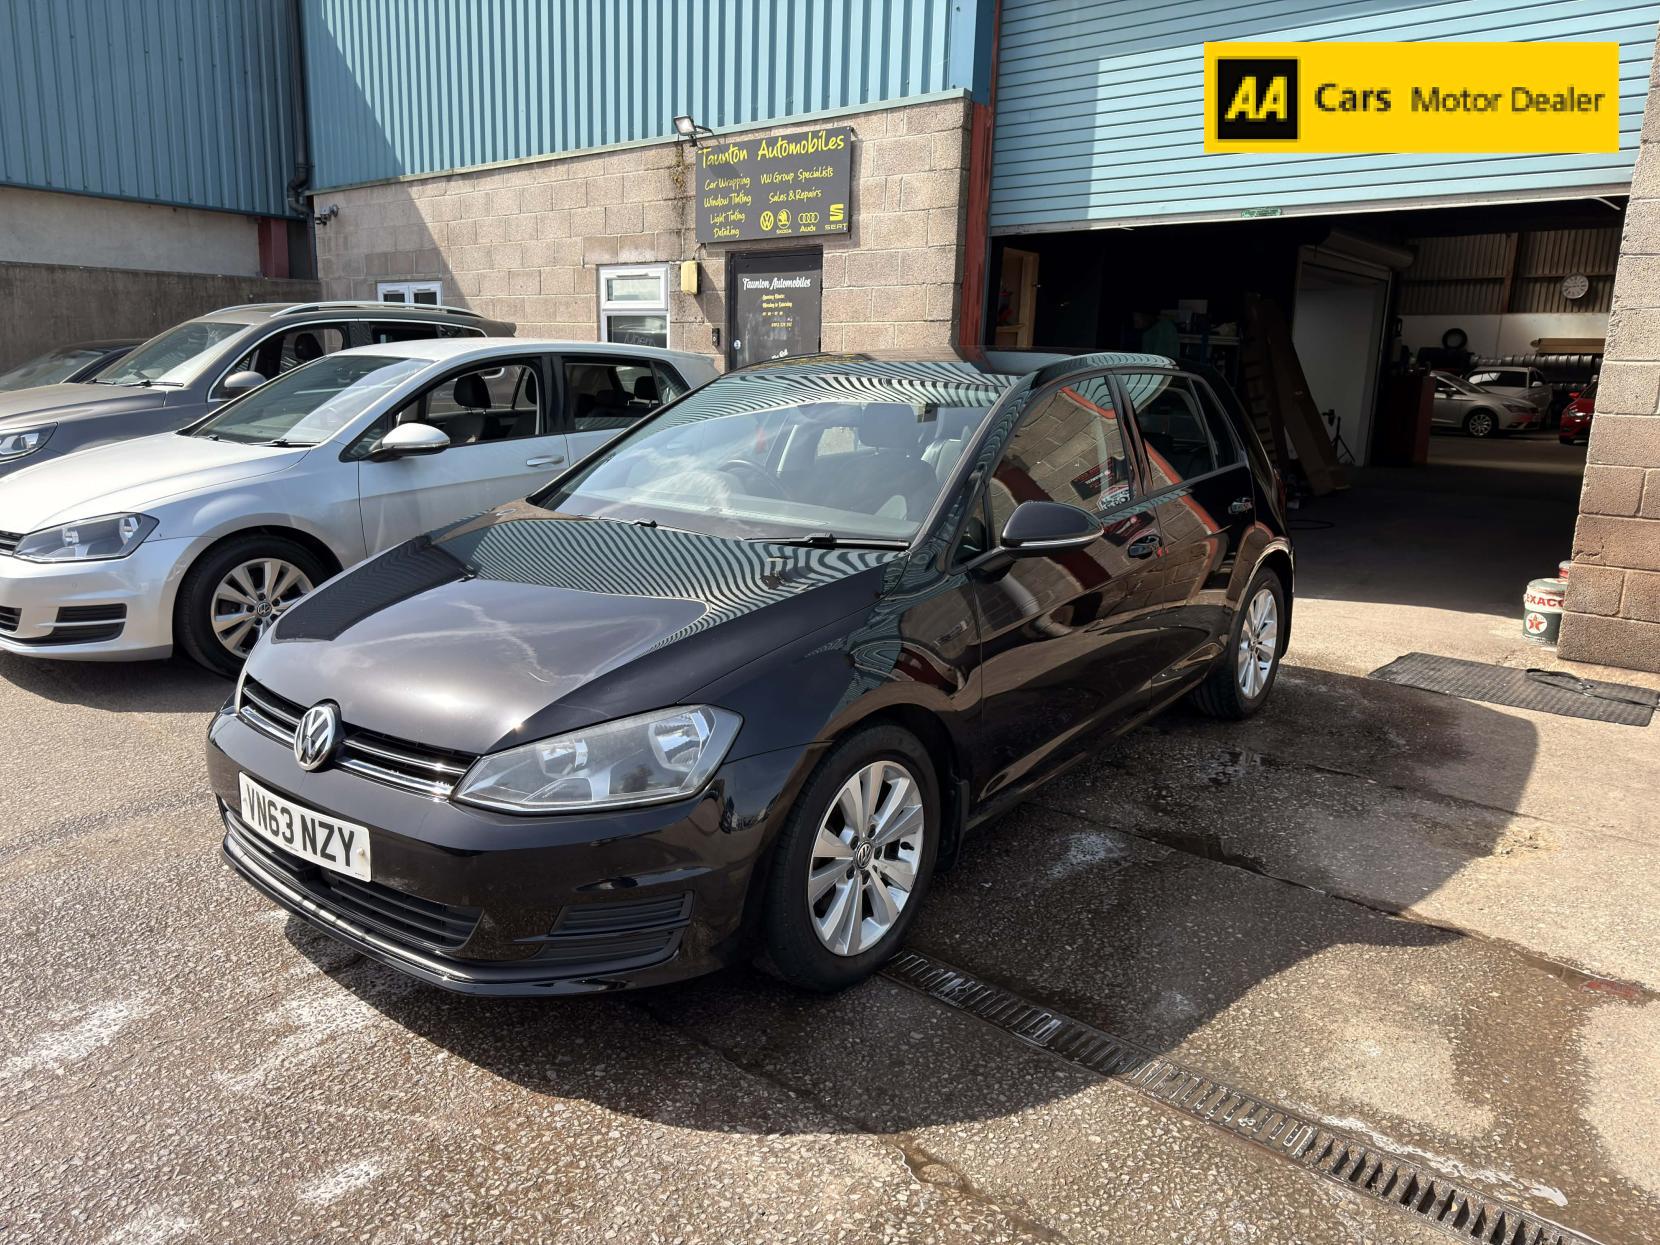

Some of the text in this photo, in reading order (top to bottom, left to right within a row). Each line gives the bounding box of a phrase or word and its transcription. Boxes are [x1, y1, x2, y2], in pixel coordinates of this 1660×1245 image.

[698, 130, 845, 168] Taunton Automobiles
[704, 173, 751, 191] Car Wrapping
[773, 171, 795, 185] Group
[797, 166, 834, 183] Specialists
[703, 190, 752, 208] Window Tinting
[768, 187, 822, 204] Sales & Repairs
[710, 212, 726, 226] Light
[799, 225, 816, 233] Audi
[742, 276, 811, 290] Taunton Automobiles
[246, 783, 355, 868] VN63 NZY
